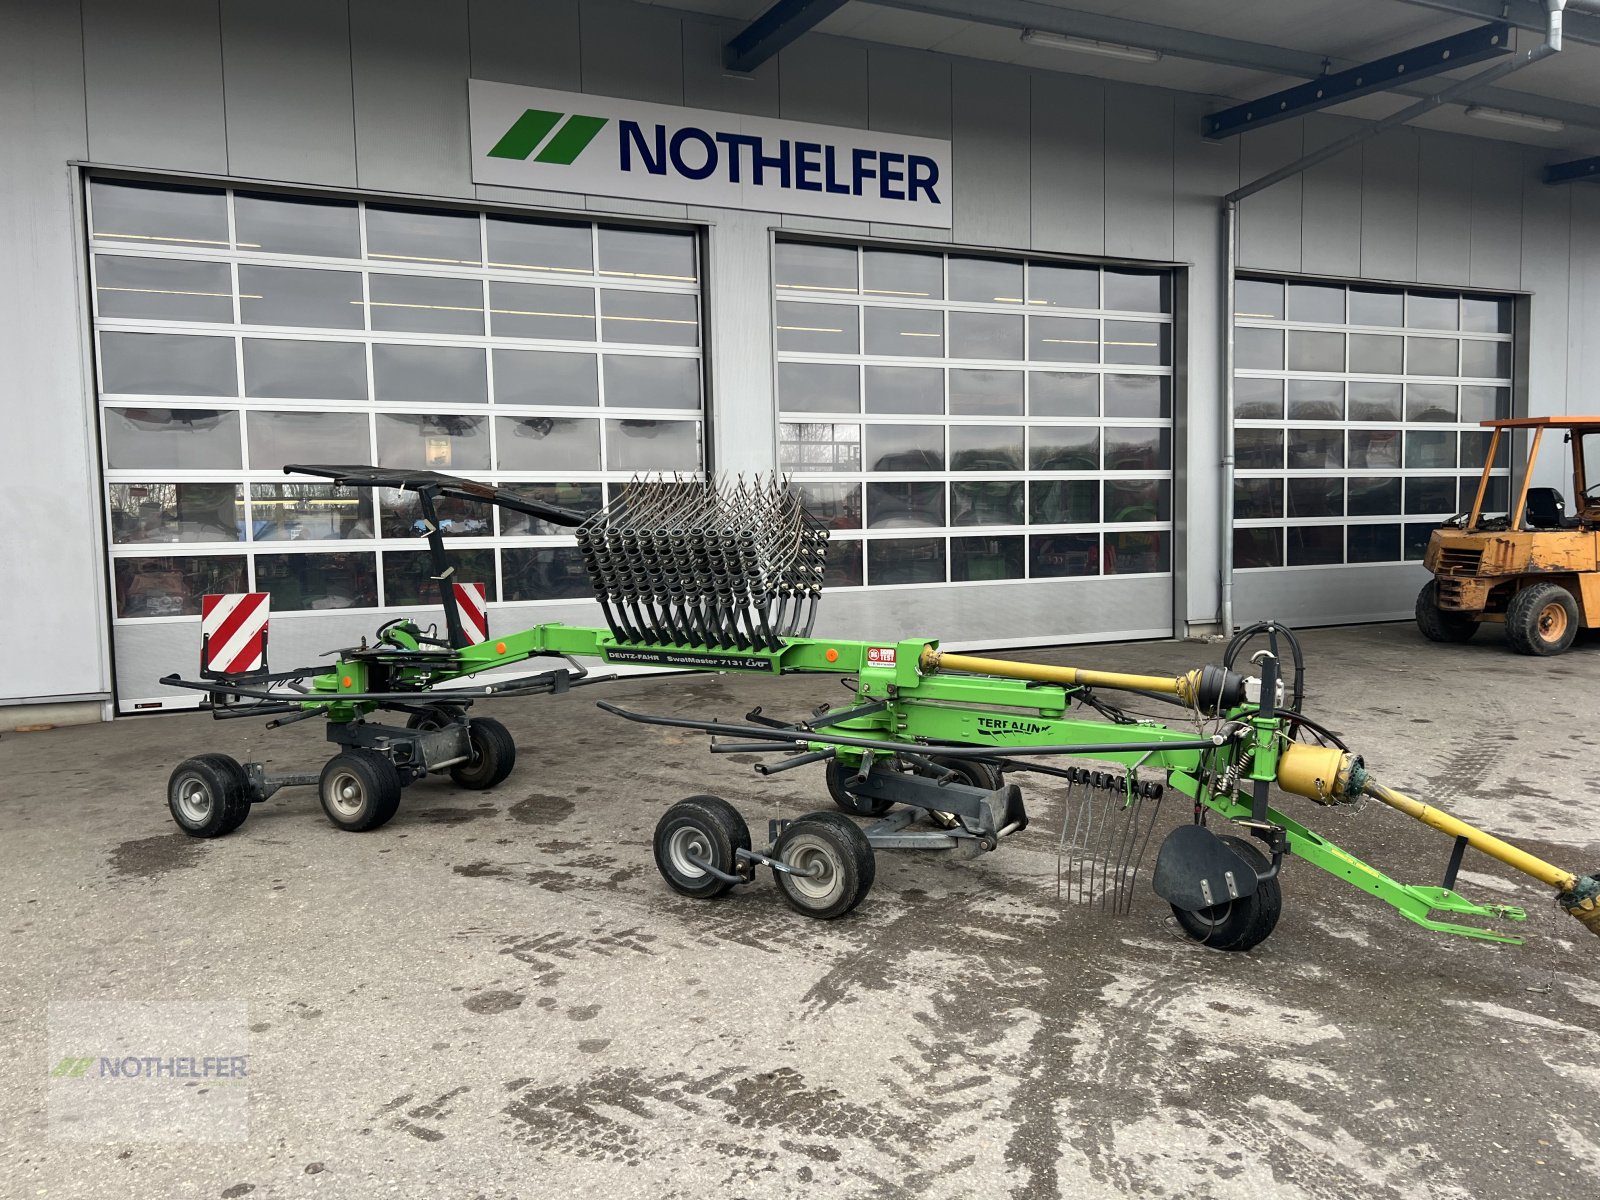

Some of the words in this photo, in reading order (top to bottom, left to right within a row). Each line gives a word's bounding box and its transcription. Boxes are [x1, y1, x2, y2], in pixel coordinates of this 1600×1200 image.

[618, 119, 942, 204] NOTHELFER
[608, 652, 660, 661] DEUTZ-FAHR
[666, 655, 718, 665] SwatMaster
